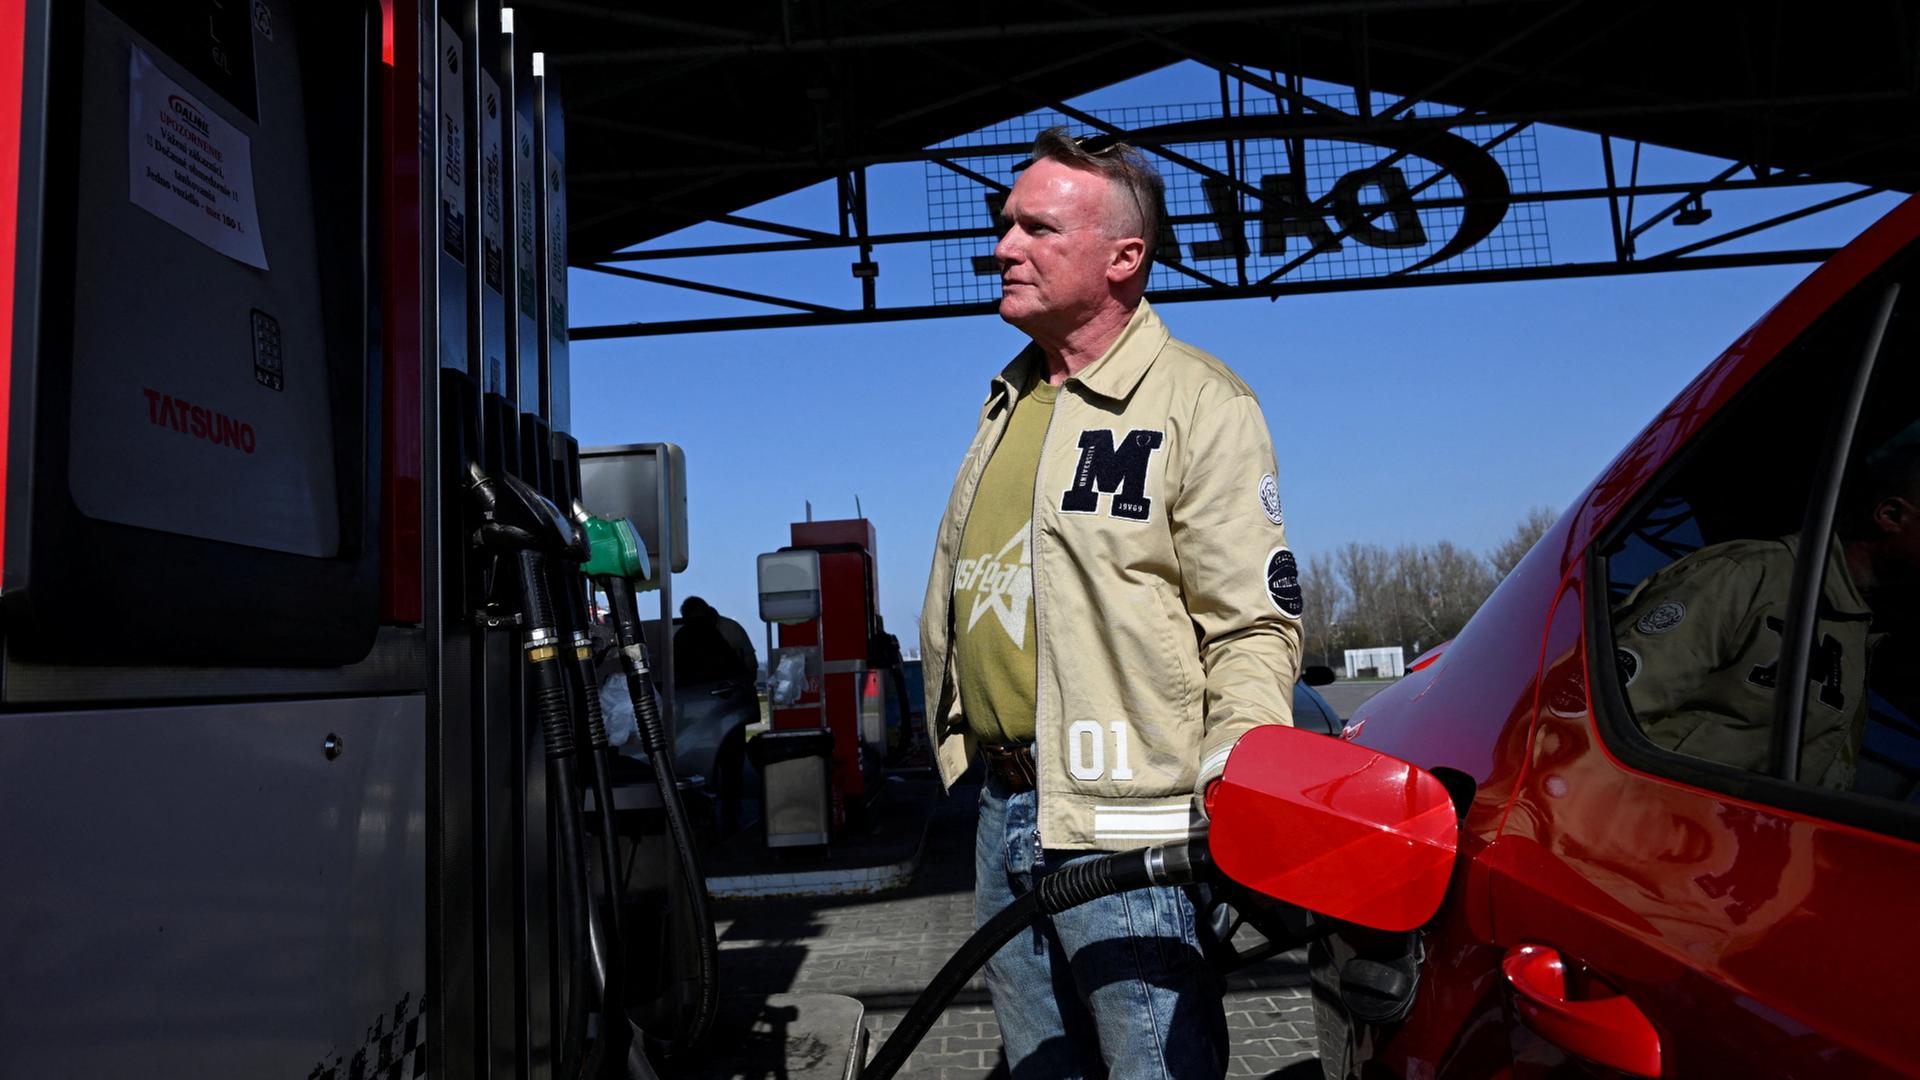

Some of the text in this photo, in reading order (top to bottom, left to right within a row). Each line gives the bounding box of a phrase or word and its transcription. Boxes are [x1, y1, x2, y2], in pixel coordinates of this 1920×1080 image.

[160, 110, 223, 162] UPOZORNENIE
[444, 113, 453, 182] Diesel
[144, 388, 256, 454] TATSUNO
[1060, 428, 1164, 522] M
[1069, 719, 1133, 779] 01
